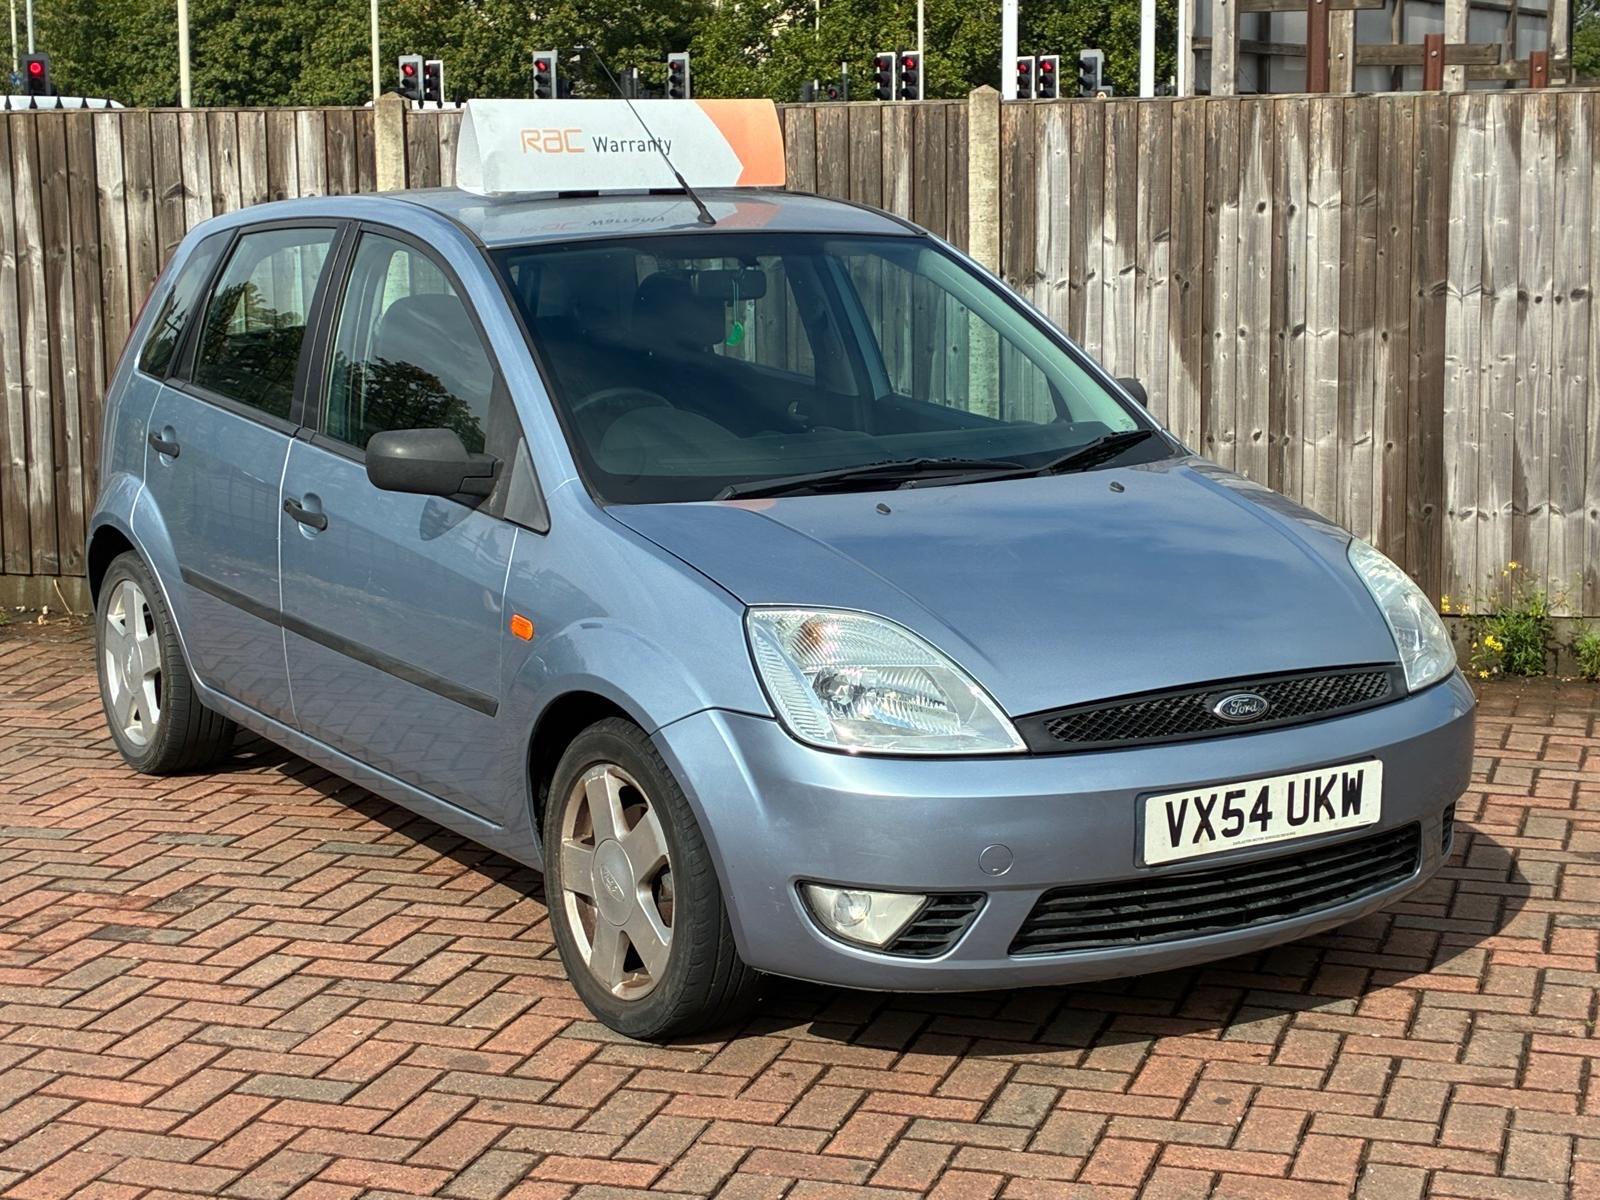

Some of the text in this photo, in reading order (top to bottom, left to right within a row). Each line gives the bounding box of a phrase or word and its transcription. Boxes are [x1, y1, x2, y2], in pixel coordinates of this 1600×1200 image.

[592, 136, 672, 155] Warranty
[1230, 698, 1258, 715] Ford
[1165, 769, 1365, 848] VX54 UKW
